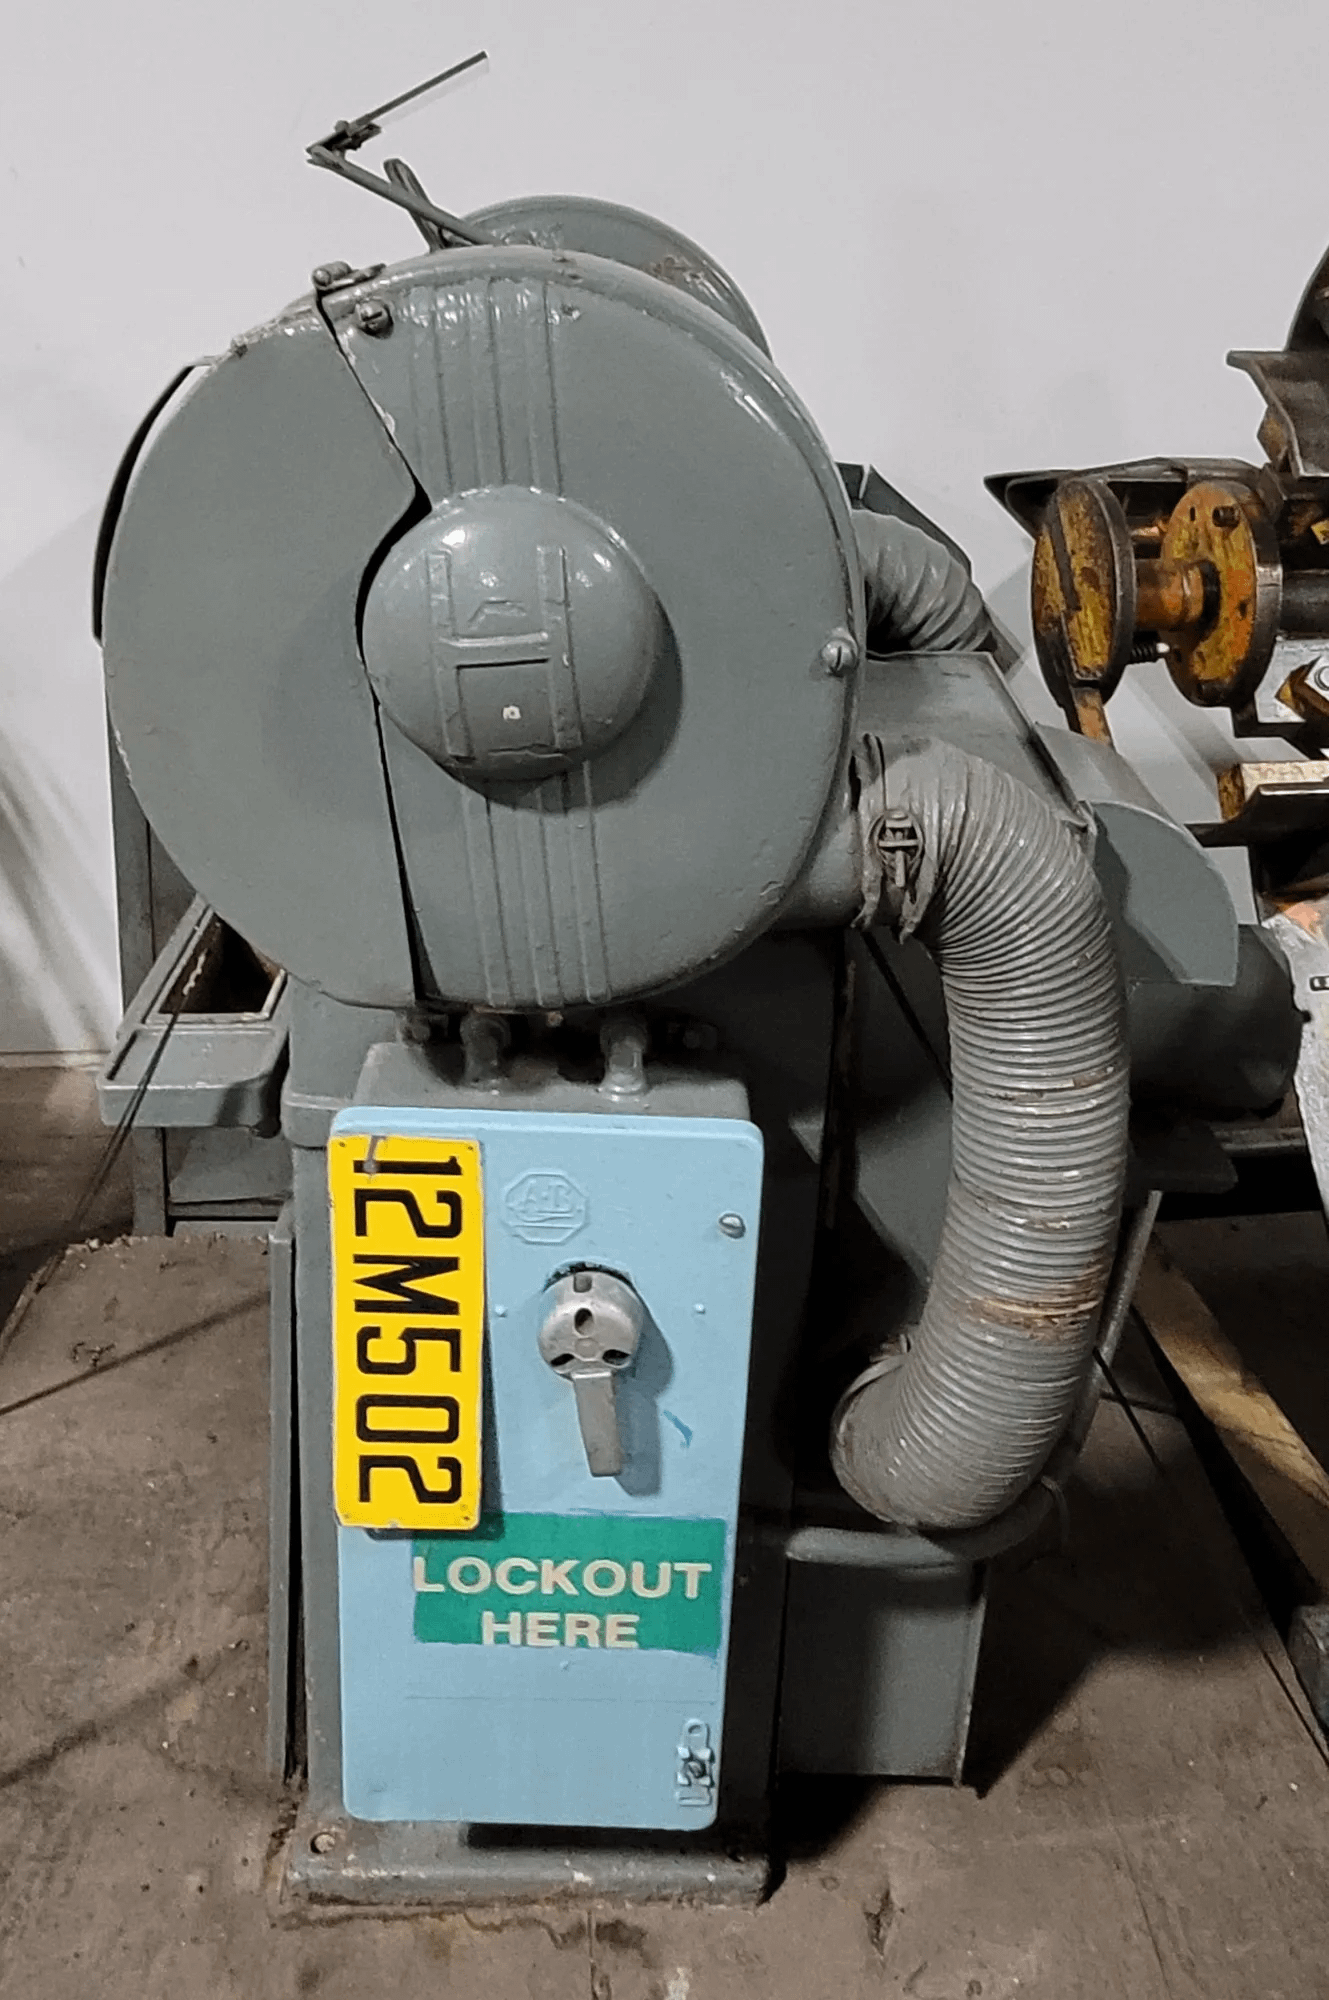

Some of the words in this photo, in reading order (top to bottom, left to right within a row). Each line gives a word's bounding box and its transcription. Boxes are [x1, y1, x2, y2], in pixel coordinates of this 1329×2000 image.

[354, 1155, 462, 1505] 12M502
[412, 1555, 713, 1600] LOCKOUT
[482, 1610, 641, 1649] HERE
